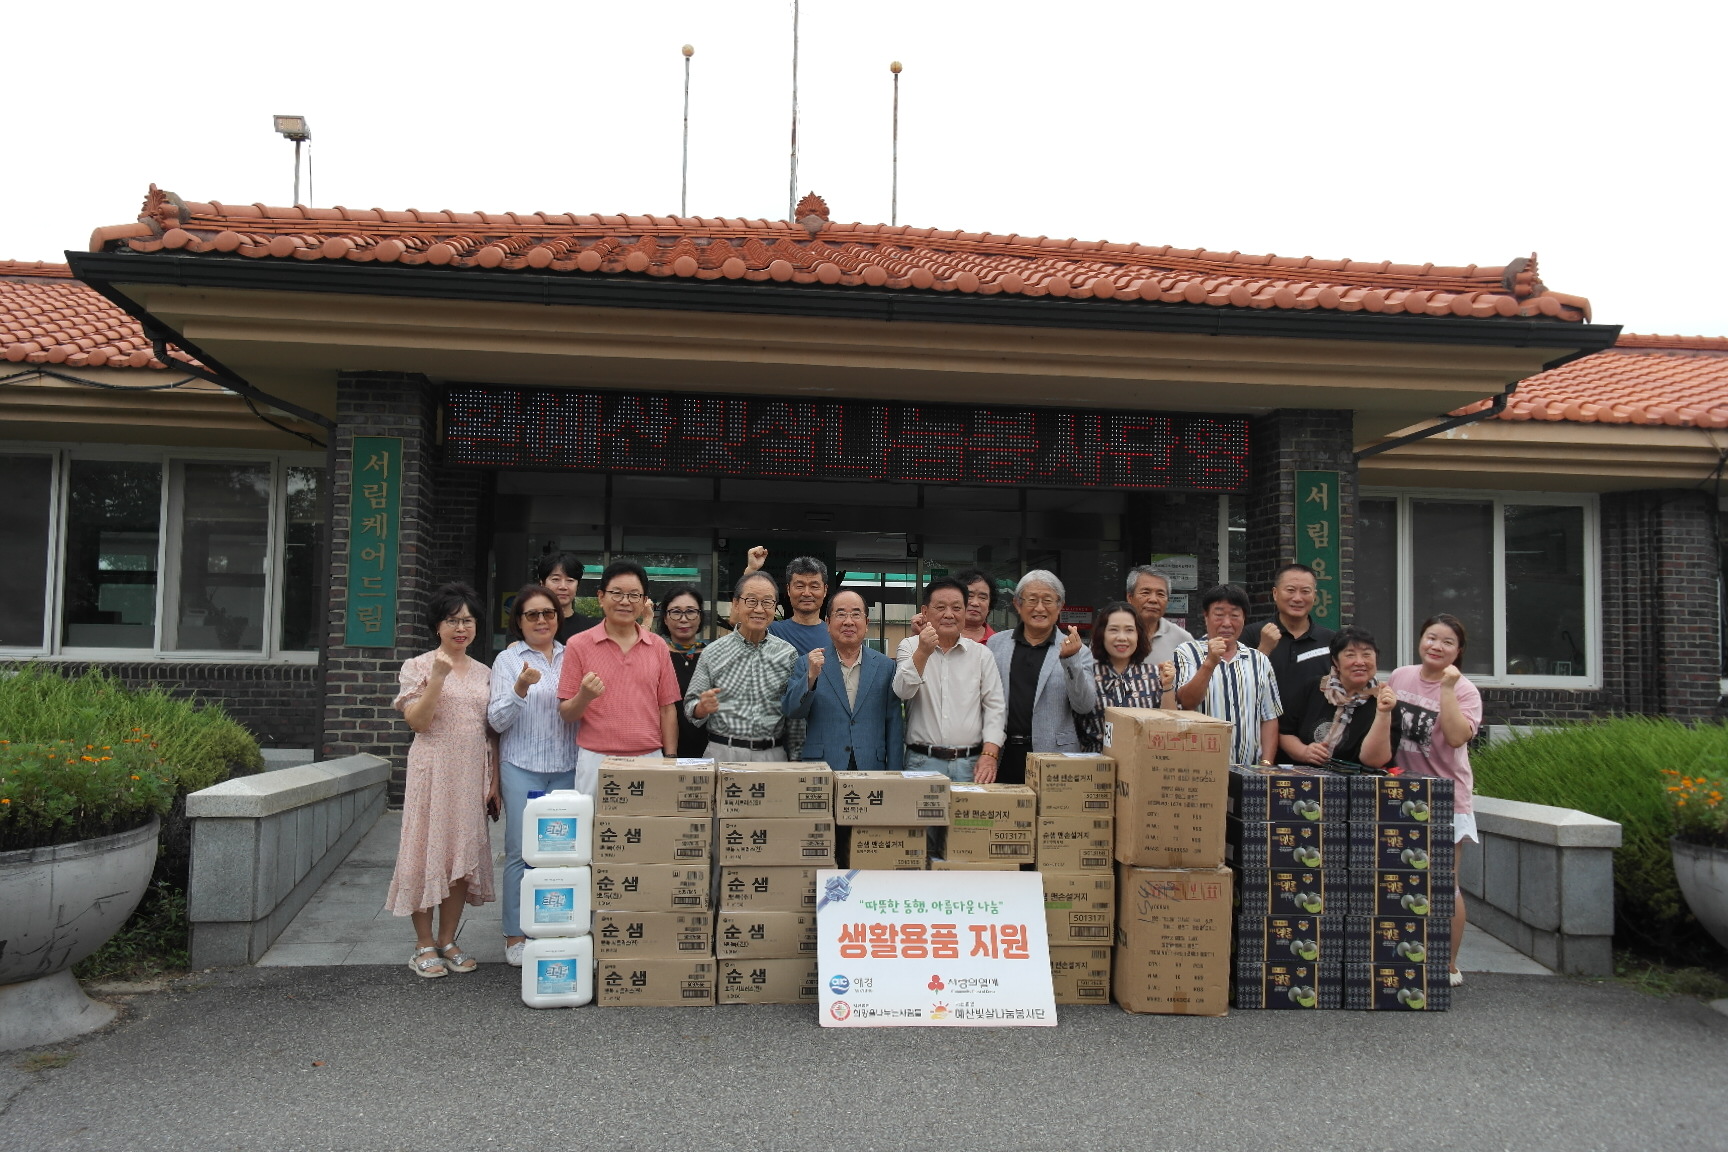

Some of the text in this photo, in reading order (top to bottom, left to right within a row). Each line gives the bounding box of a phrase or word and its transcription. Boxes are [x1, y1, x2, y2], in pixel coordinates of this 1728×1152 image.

[357, 450, 389, 634] 서림케어드림
[994, 831, 1026, 840] 5013171
[1050, 892, 1088, 902] 맨손설거지
[903, 899, 929, 914] 동행,
[931, 900, 975, 915] 아름다운
[1073, 914, 1106, 922] 5013171
[838, 922, 1030, 959] 생활용품 지원
[853, 977, 873, 988] 애경
